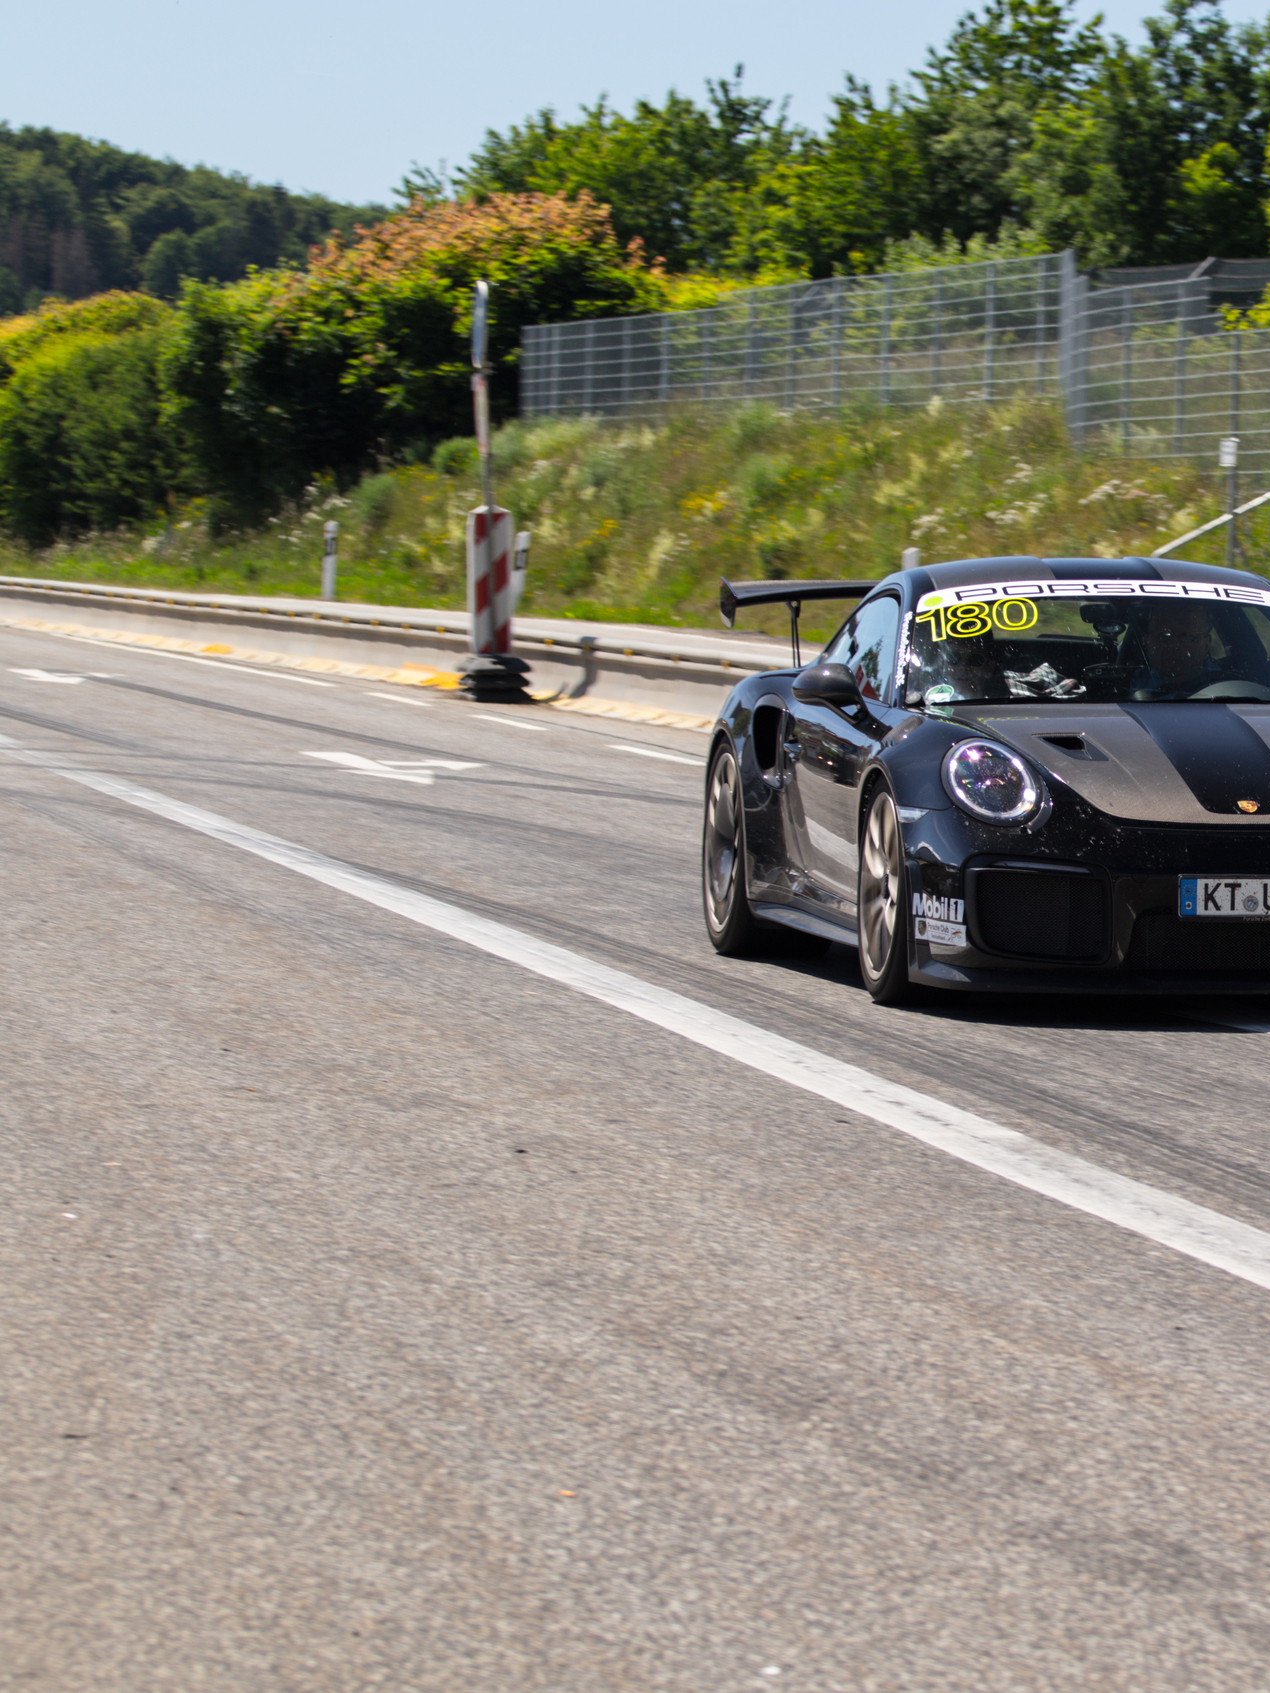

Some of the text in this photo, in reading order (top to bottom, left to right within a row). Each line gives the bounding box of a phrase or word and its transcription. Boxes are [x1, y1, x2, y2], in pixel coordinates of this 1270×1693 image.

[955, 583, 1265, 603] PORSCHE
[915, 597, 1039, 642] 180
[912, 892, 948, 920] Mobil
[1203, 882, 1242, 911] KT
